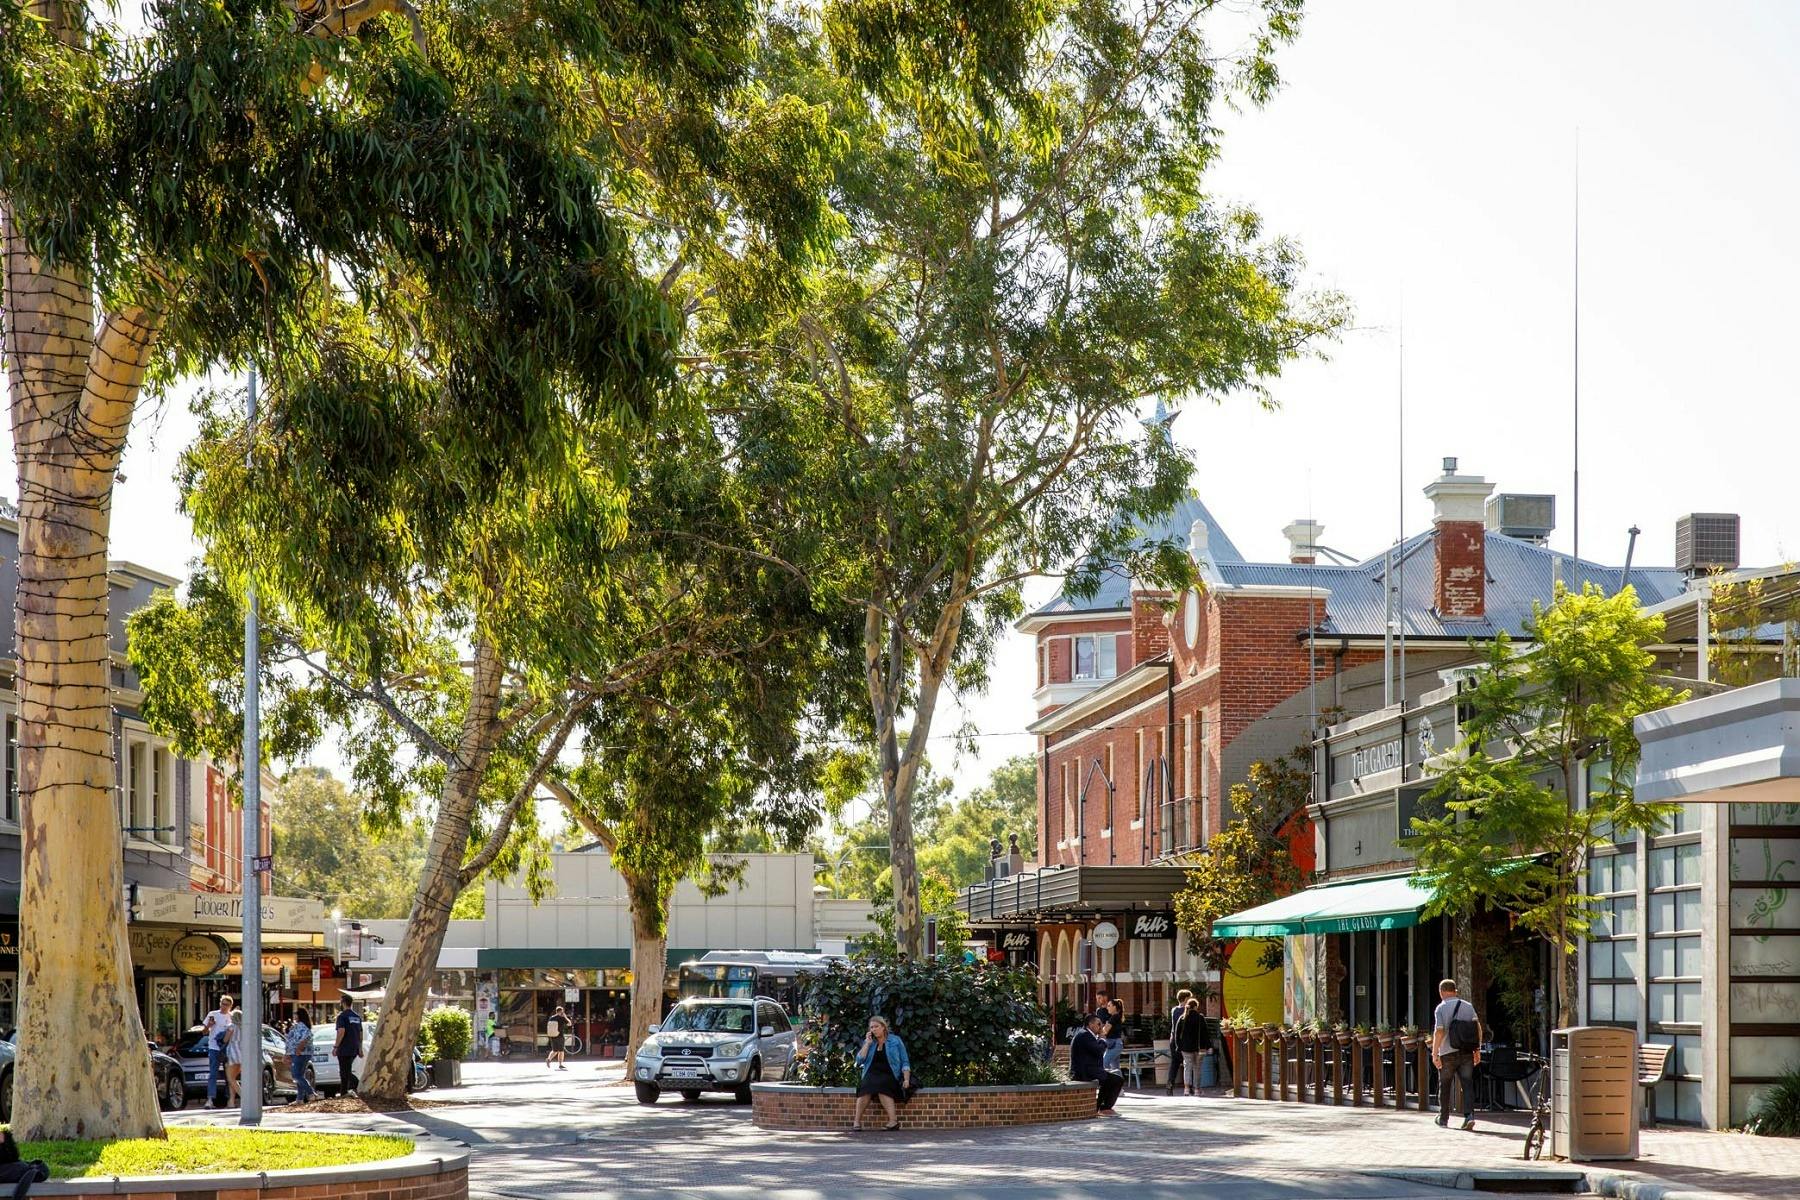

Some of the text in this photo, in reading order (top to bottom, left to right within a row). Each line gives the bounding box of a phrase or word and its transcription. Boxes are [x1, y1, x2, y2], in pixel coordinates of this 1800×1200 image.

[1352, 740, 1402, 778] THE GARDE
[1134, 915, 1168, 934] Bill's
[1337, 918, 1349, 931] THE
[1003, 932, 1030, 948] Bill's
